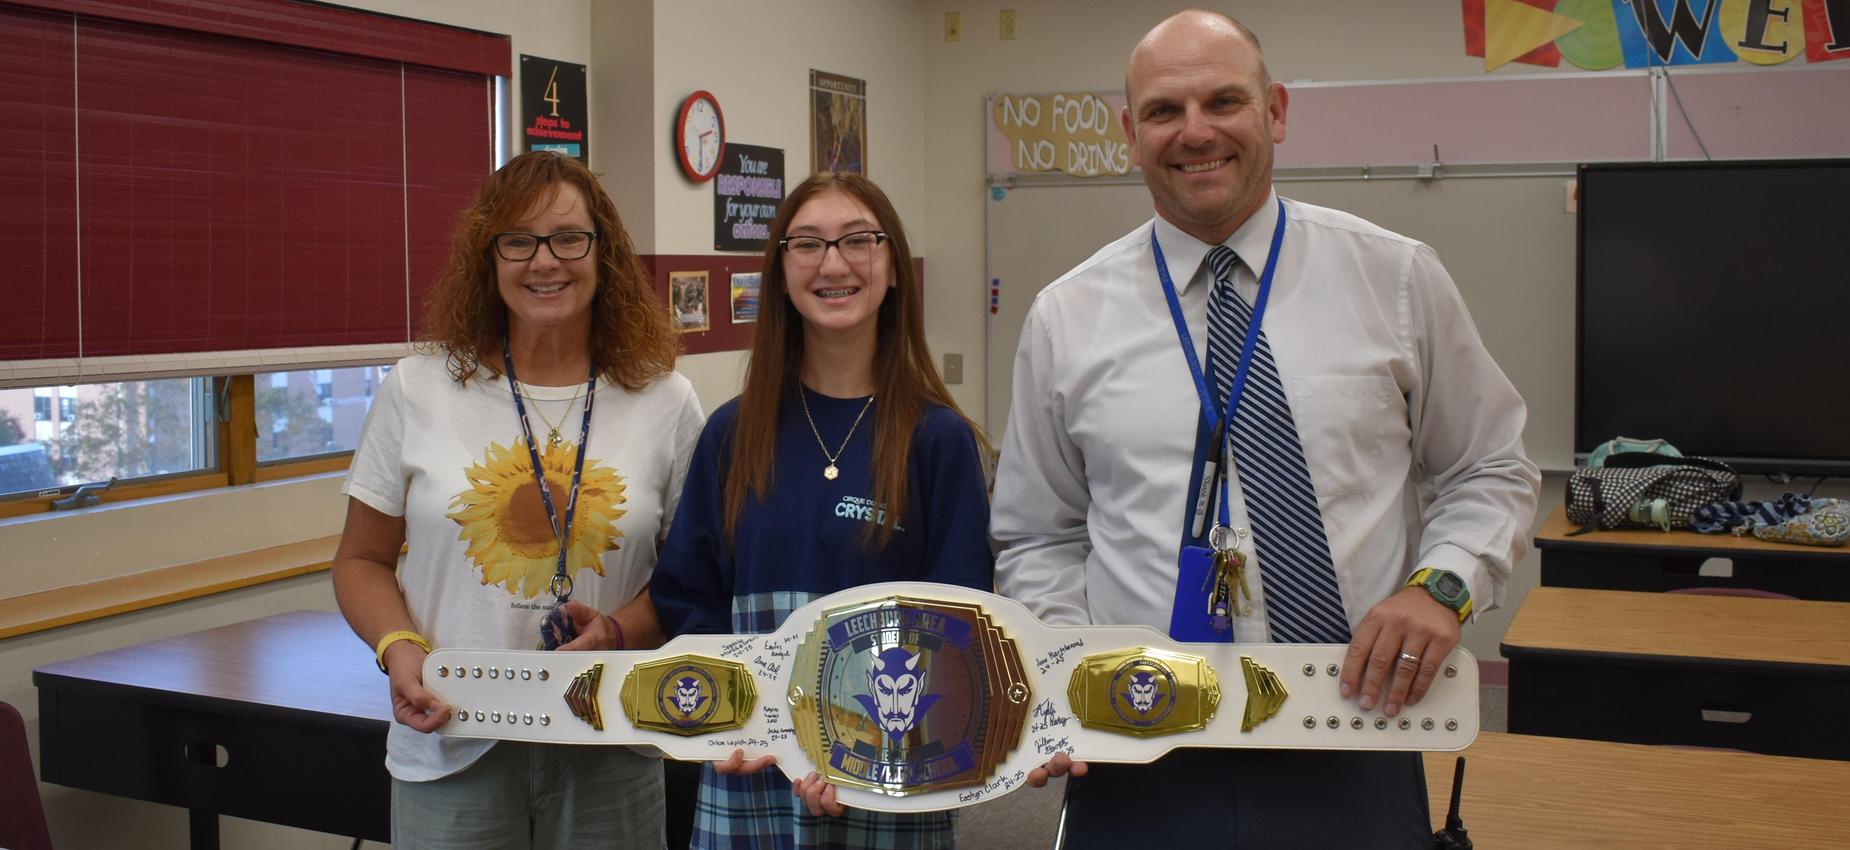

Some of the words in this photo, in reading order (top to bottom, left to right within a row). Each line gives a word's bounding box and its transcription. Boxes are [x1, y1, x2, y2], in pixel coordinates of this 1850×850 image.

[543, 65, 560, 117] 4
[535, 116, 559, 129] steps
[560, 118, 570, 129] to
[1003, 95, 1040, 128] NO
[1052, 94, 1109, 135] FOOD
[527, 126, 583, 141] achievement
[738, 153, 756, 174] You
[756, 161, 769, 175] are
[1018, 139, 1055, 170] NO
[1067, 140, 1129, 176] DRINKS
[717, 173, 782, 199] RESPONSIBLE
[724, 196, 740, 223] for
[739, 203, 760, 223] your
[760, 204, 776, 218] own
[842, 495, 866, 505] CIRQUE
[510, 602, 530, 610] follow
[531, 602, 541, 610] the
[912, 612, 947, 635] AREA
[984, 775, 1008, 794] Clark
